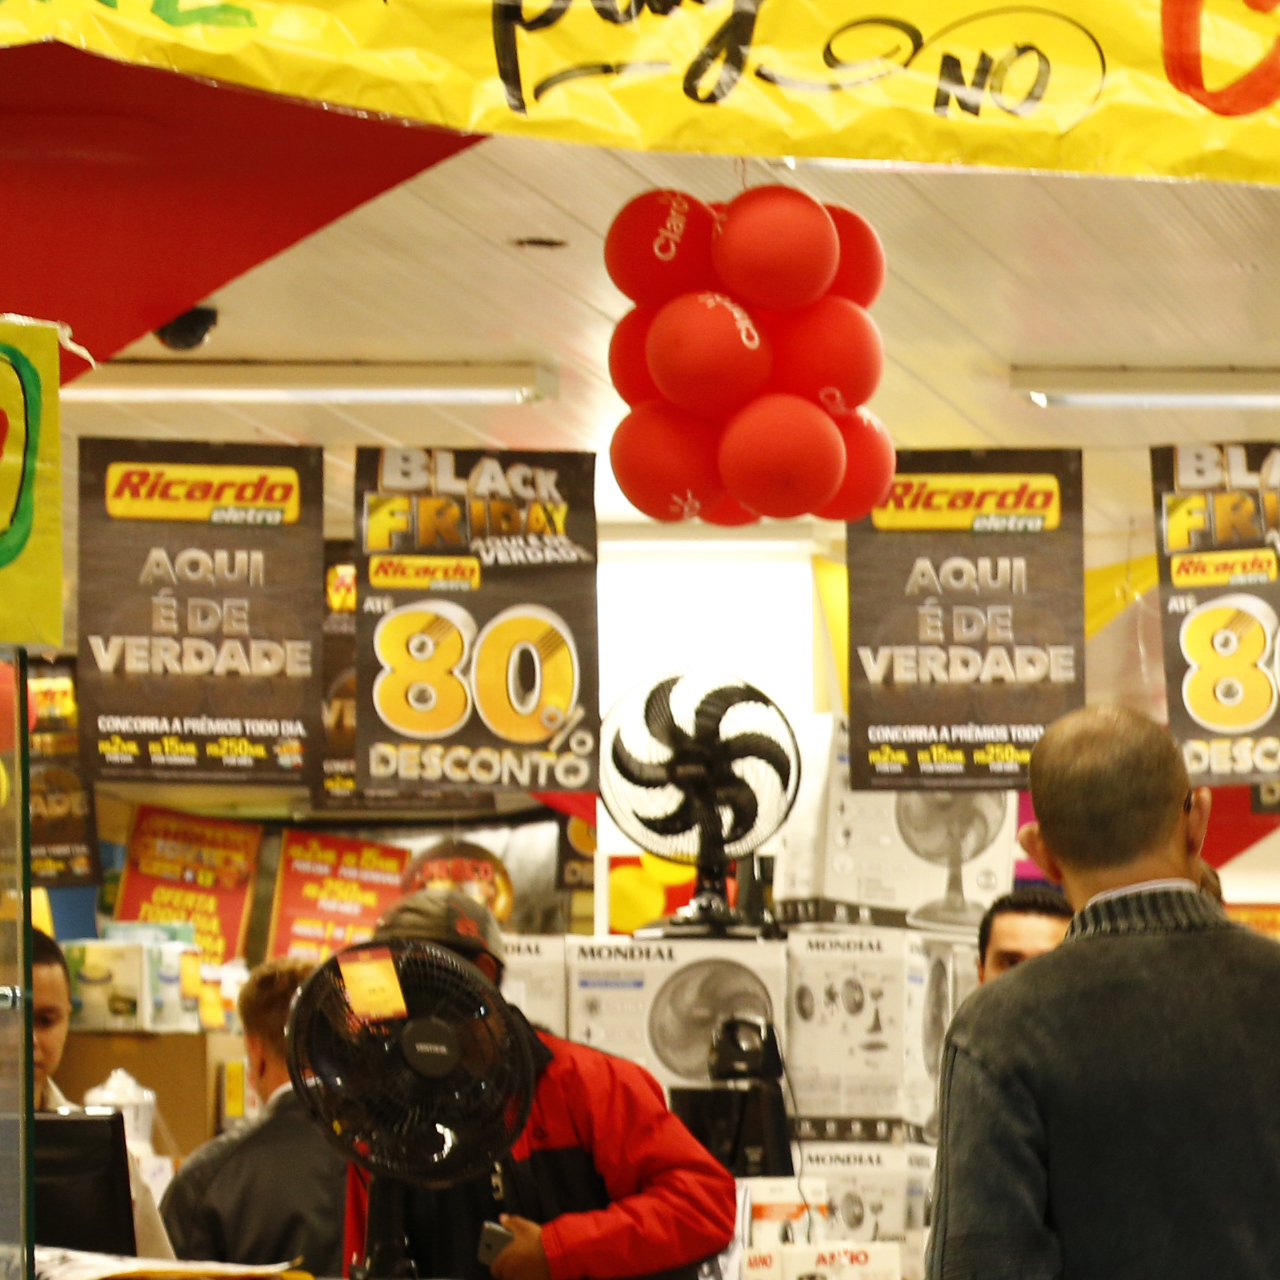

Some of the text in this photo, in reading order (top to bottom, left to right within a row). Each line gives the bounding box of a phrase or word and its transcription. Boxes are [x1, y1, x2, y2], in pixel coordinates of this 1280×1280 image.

[934, 44, 1050, 118] NO
[112, 469, 293, 506] Ricardo
[378, 449, 564, 504] BLACK
[888, 479, 1053, 513] Ricardo
[211, 508, 283, 526] eletro
[363, 492, 569, 553] FRIDAY
[972, 514, 1045, 531] eletro
[139, 548, 265, 586] AQUI
[374, 559, 477, 578] Ricardo
[906, 557, 1027, 595] AQUI
[1177, 557, 1273, 576] Ricardo
[188, 597, 250, 636] DE
[954, 604, 1015, 642] DE
[89, 636, 313, 678] VERDADE
[858, 645, 1076, 684] VERDADE
[372, 599, 594, 756] 80%
[368, 742, 590, 790] DESCONTO
[577, 944, 676, 962] MONDIAL
[805, 939, 882, 953] MONDIAL
[805, 1154, 883, 1167] MONDIAL
